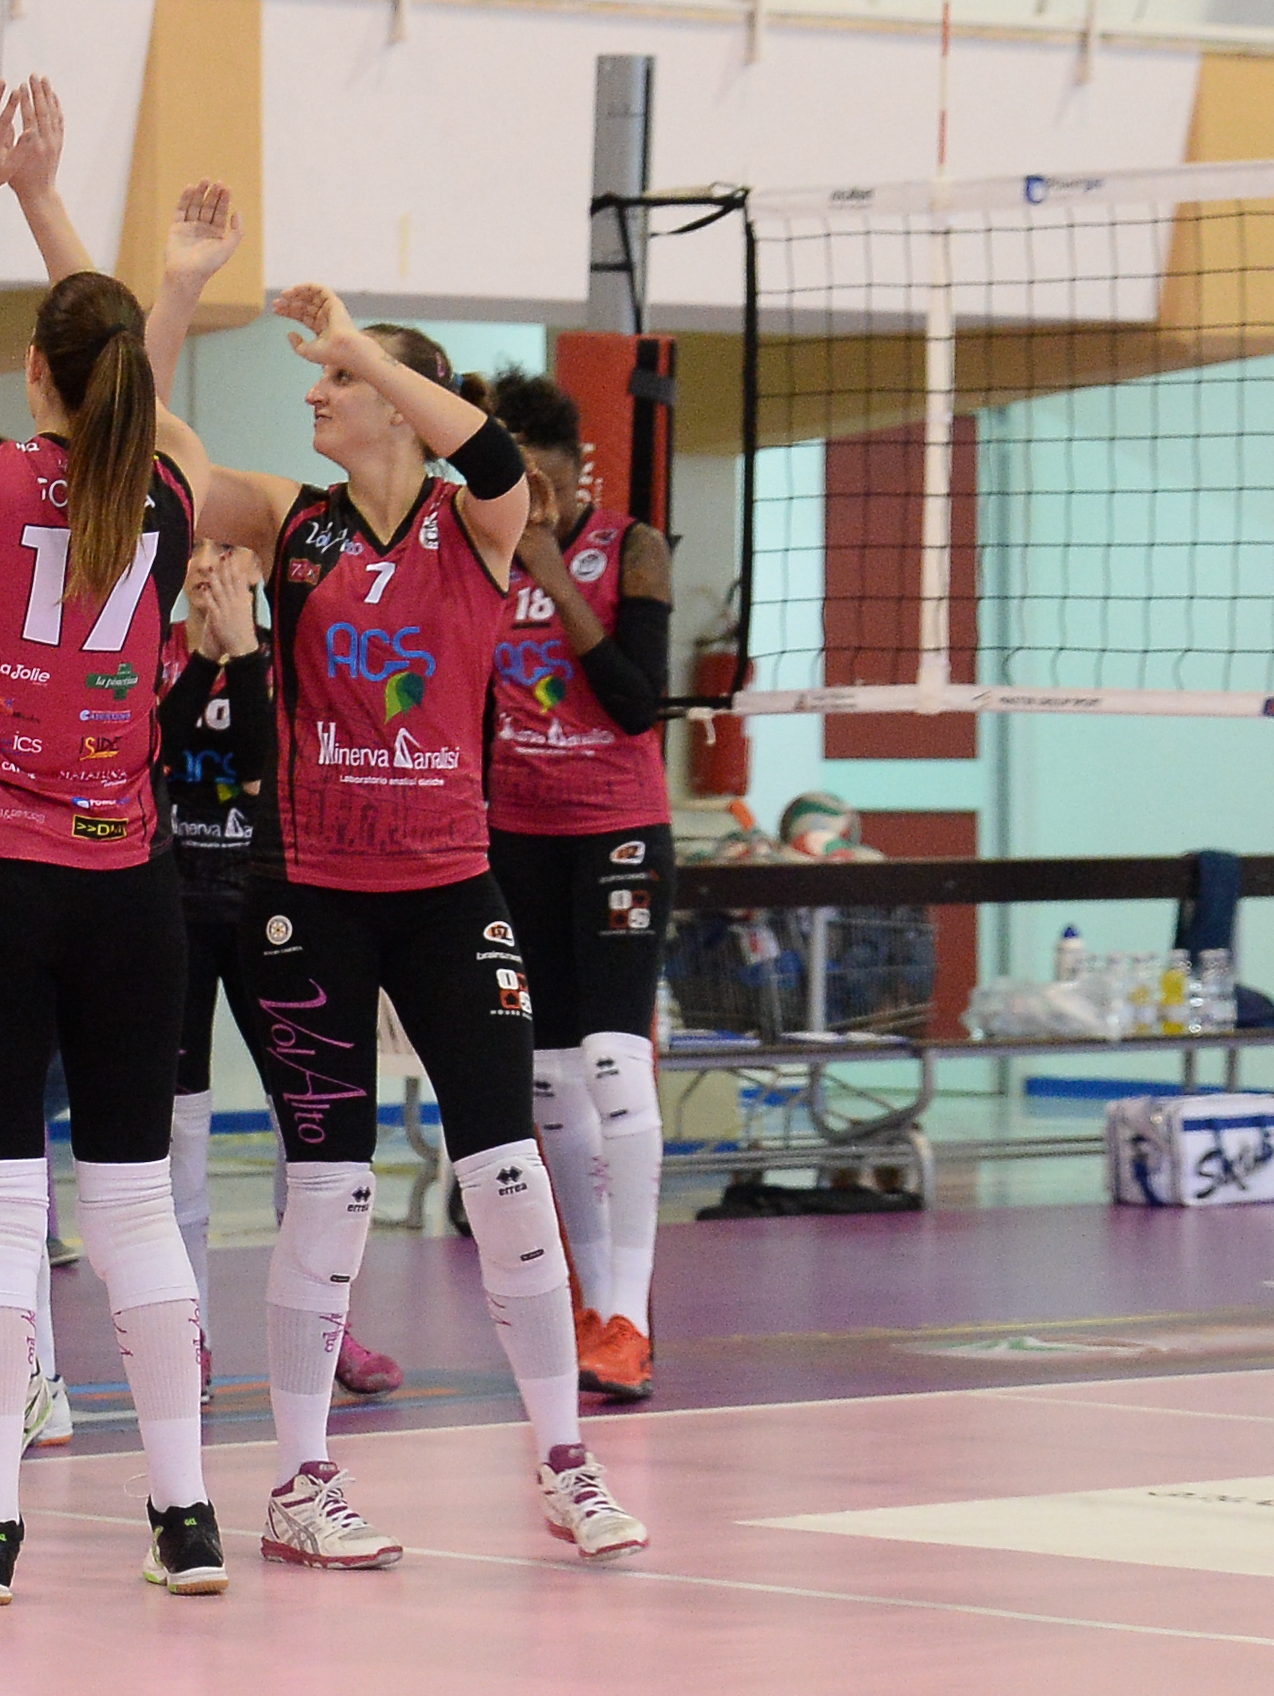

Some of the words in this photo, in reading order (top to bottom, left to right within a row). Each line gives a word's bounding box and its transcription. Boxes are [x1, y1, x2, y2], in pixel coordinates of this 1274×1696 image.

[365, 561, 397, 604] 7
[326, 621, 437, 682] ACS
[259, 978, 367, 1144] VolAlto
[498, 1183, 528, 1196] errea
